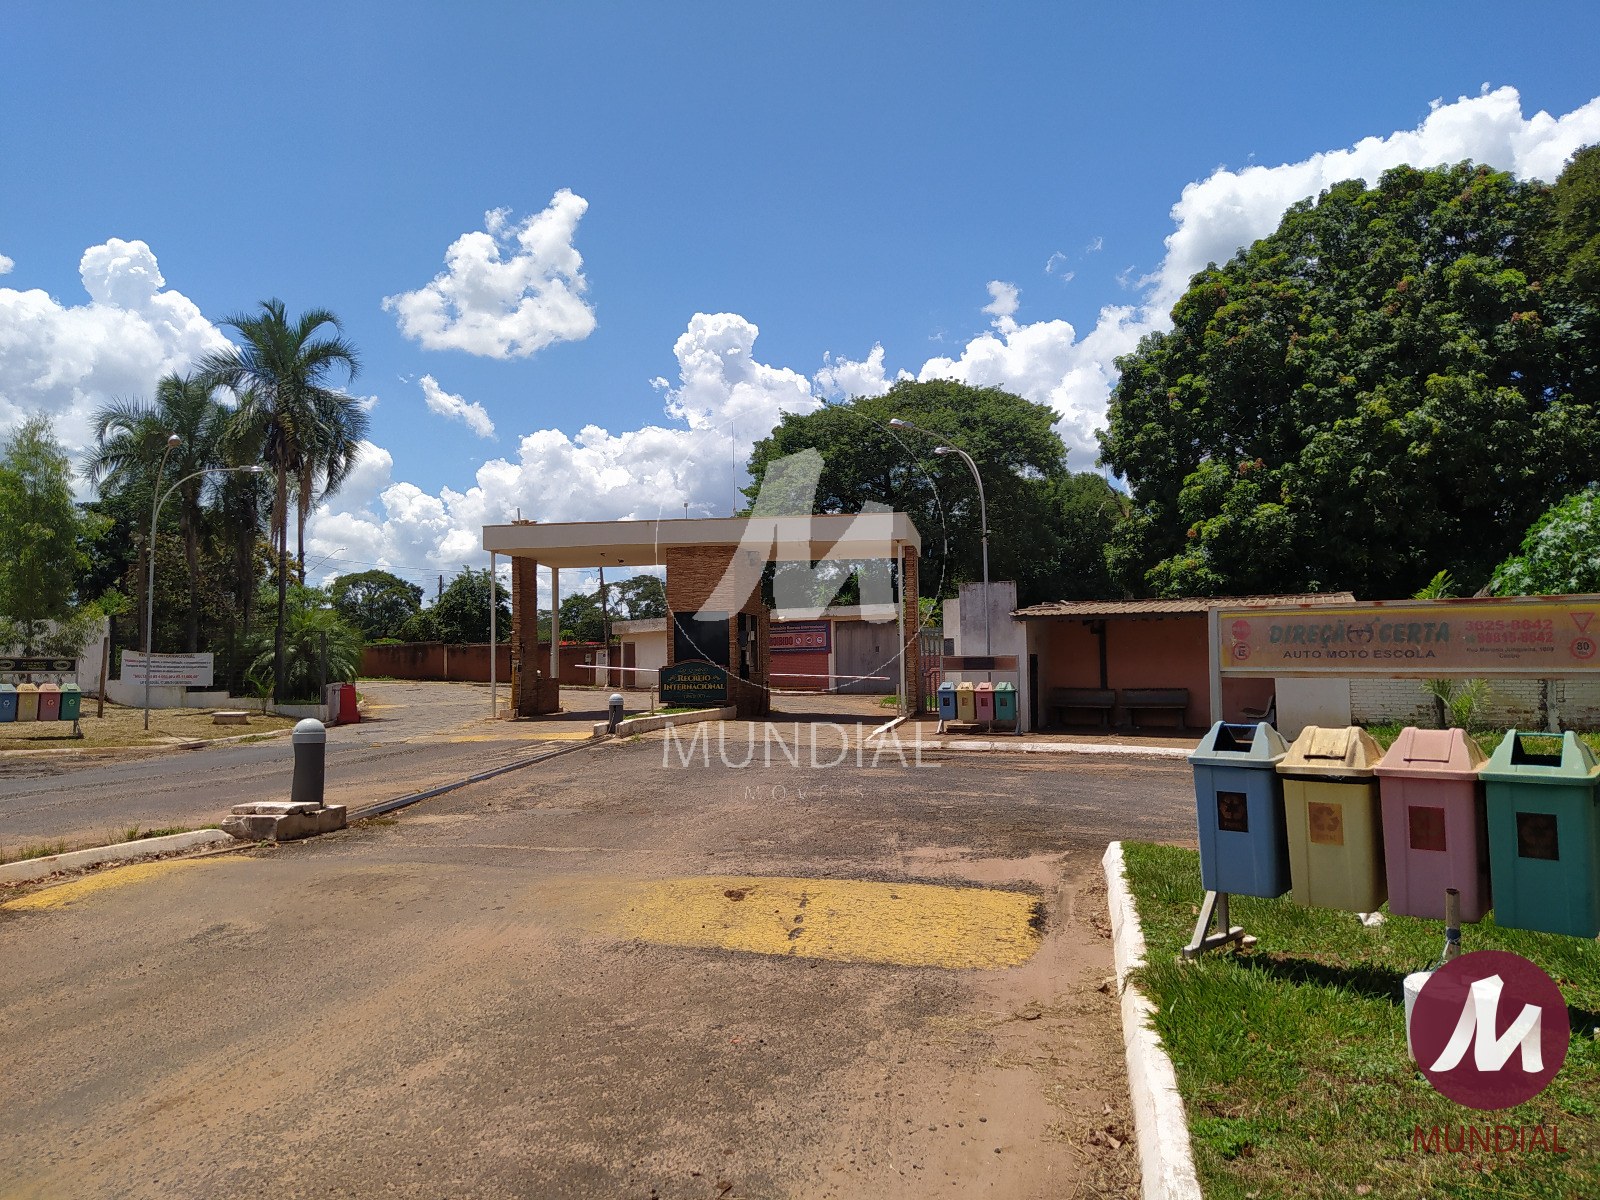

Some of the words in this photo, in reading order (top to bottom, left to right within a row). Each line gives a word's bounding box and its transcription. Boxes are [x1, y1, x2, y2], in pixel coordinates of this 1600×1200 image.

[1378, 621, 1450, 644] CERTA
[1576, 641, 1590, 651] 80
[1283, 650, 1321, 659] AUTO
[1327, 650, 1369, 658] MOTO
[1374, 649, 1436, 658] ESCOLA
[663, 683, 725, 691] INTERNACIONAL
